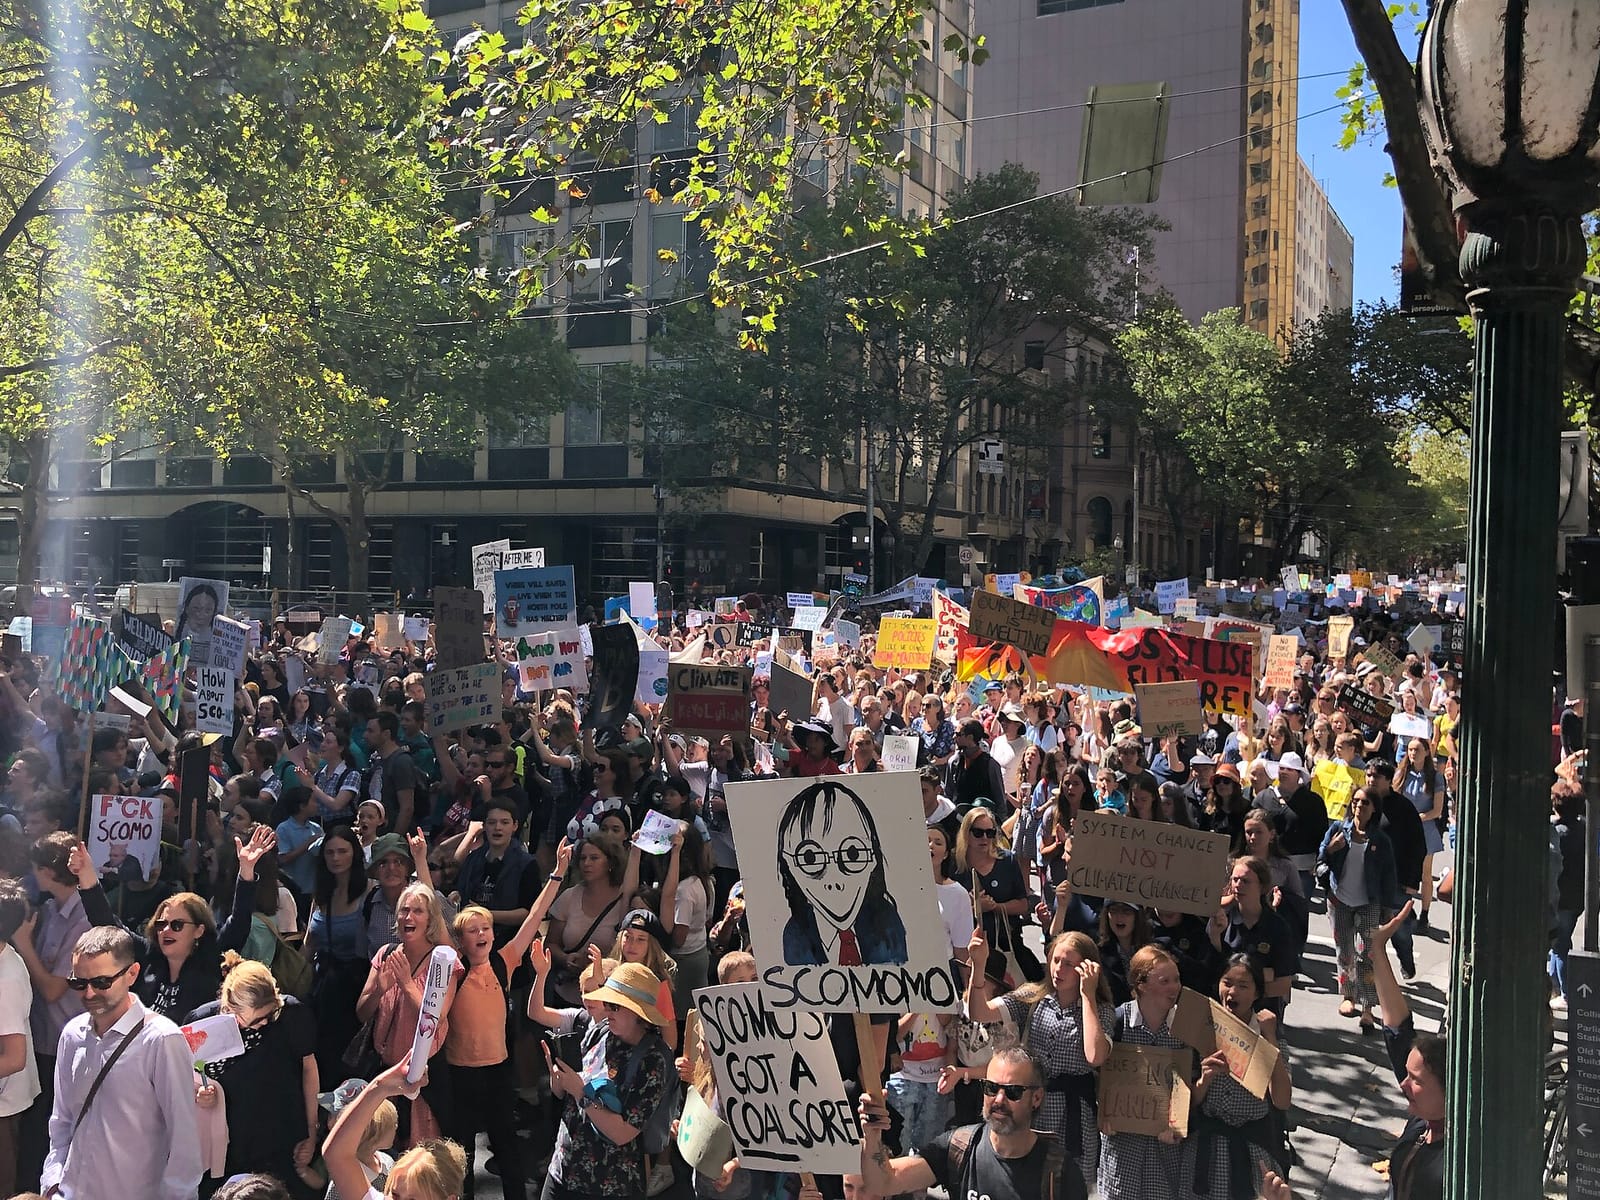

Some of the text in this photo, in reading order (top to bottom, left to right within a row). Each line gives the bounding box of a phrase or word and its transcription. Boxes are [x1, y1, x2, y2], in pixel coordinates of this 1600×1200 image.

[504, 552, 521, 566] AFTER
[517, 592, 532, 600] LIVE
[555, 591, 567, 599] THE
[551, 602, 568, 610] POLE
[986, 621, 1049, 650] MELTING
[558, 641, 579, 656] NOT
[455, 669, 469, 681] THE
[553, 661, 572, 677] AIR
[1265, 677, 1292, 685] ACTION
[198, 689, 224, 702] ABOUT
[480, 704, 493, 716] BE
[97, 820, 152, 842] SCOMO
[1082, 819, 1215, 853] SYSTEM CHANGE
[1119, 846, 1175, 871] NOT
[1071, 867, 1136, 893] CLIMATE
[763, 966, 955, 1010] SCOMOMO
[1577, 1046, 1594, 1056] Old
[726, 1051, 817, 1095] GOT A
